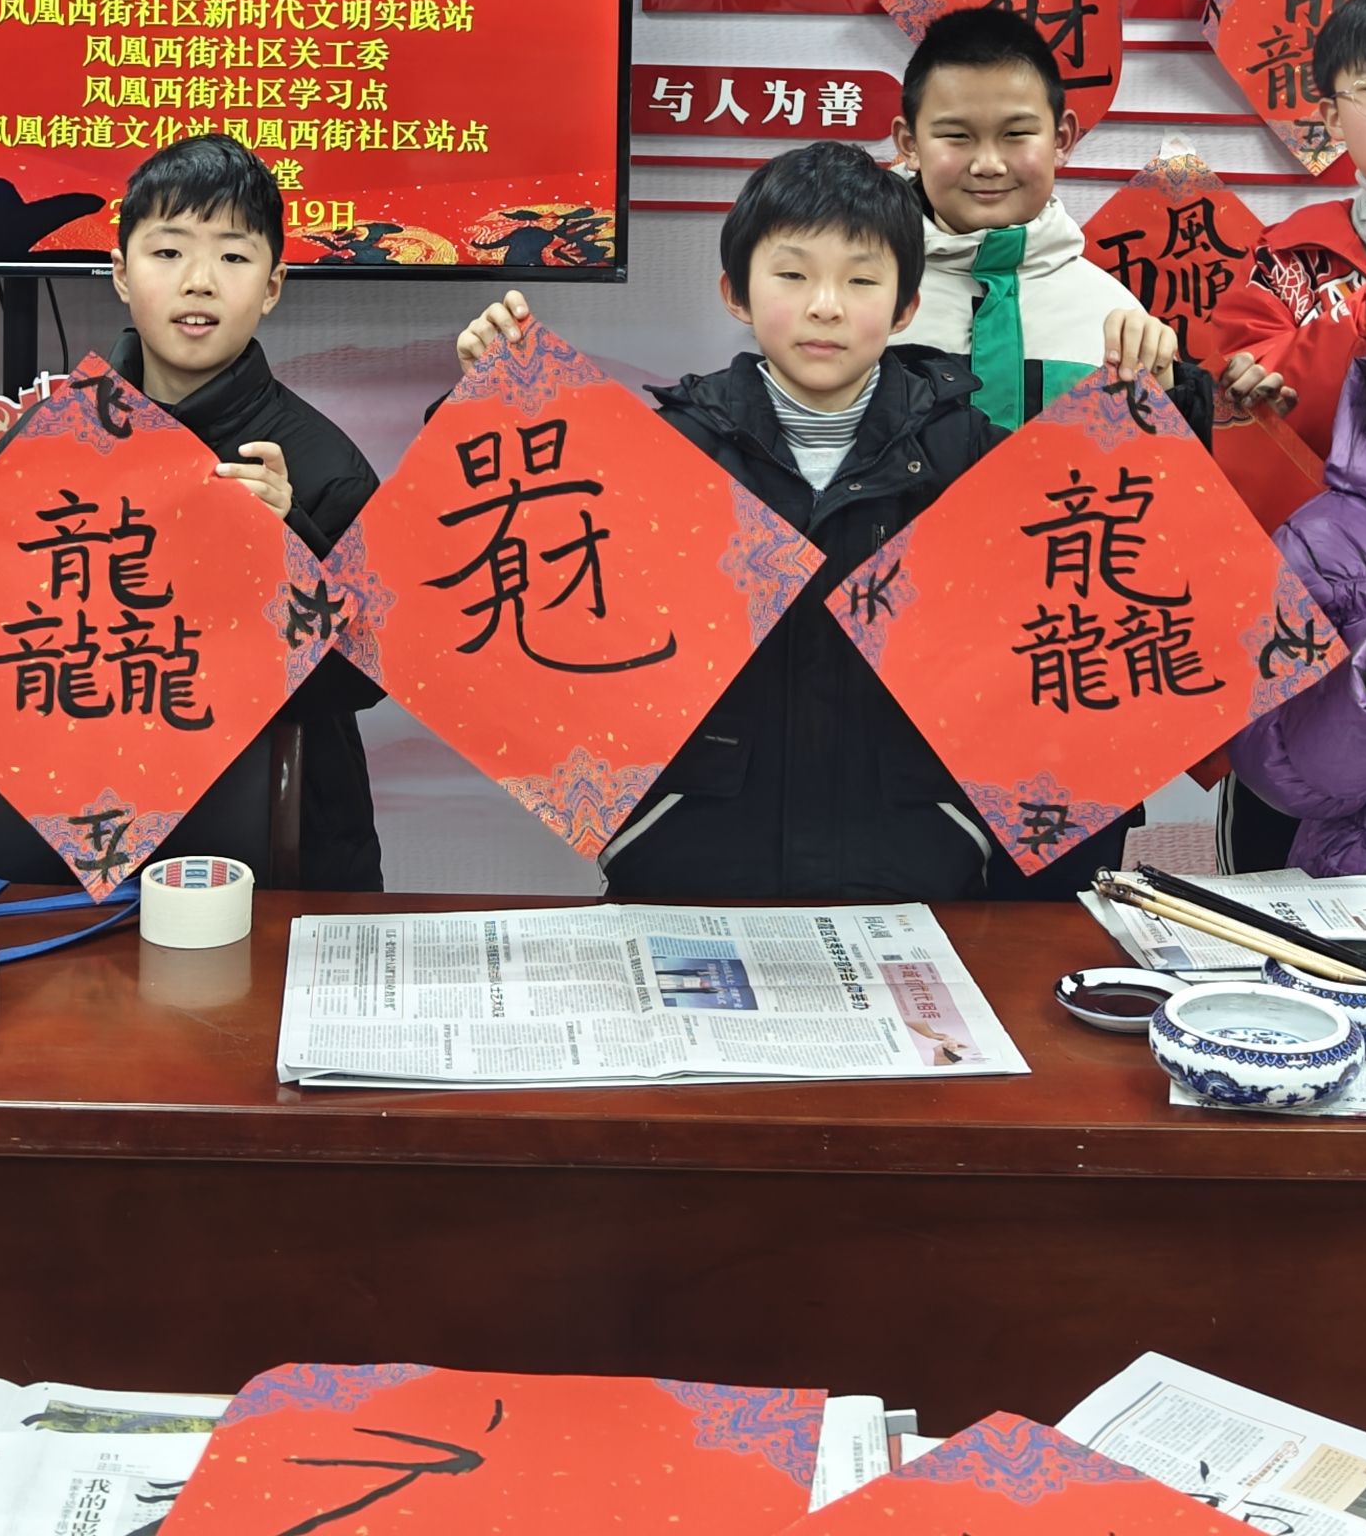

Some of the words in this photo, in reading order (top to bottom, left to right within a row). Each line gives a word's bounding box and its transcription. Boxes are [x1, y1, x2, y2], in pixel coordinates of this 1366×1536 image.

[82, 35, 390, 71] 凤凰西街社区关工委
[81, 76, 389, 112] 凤凰西街社区学习点
[648, 77, 864, 128] 与人为善
[69, 374, 135, 440] 飞
